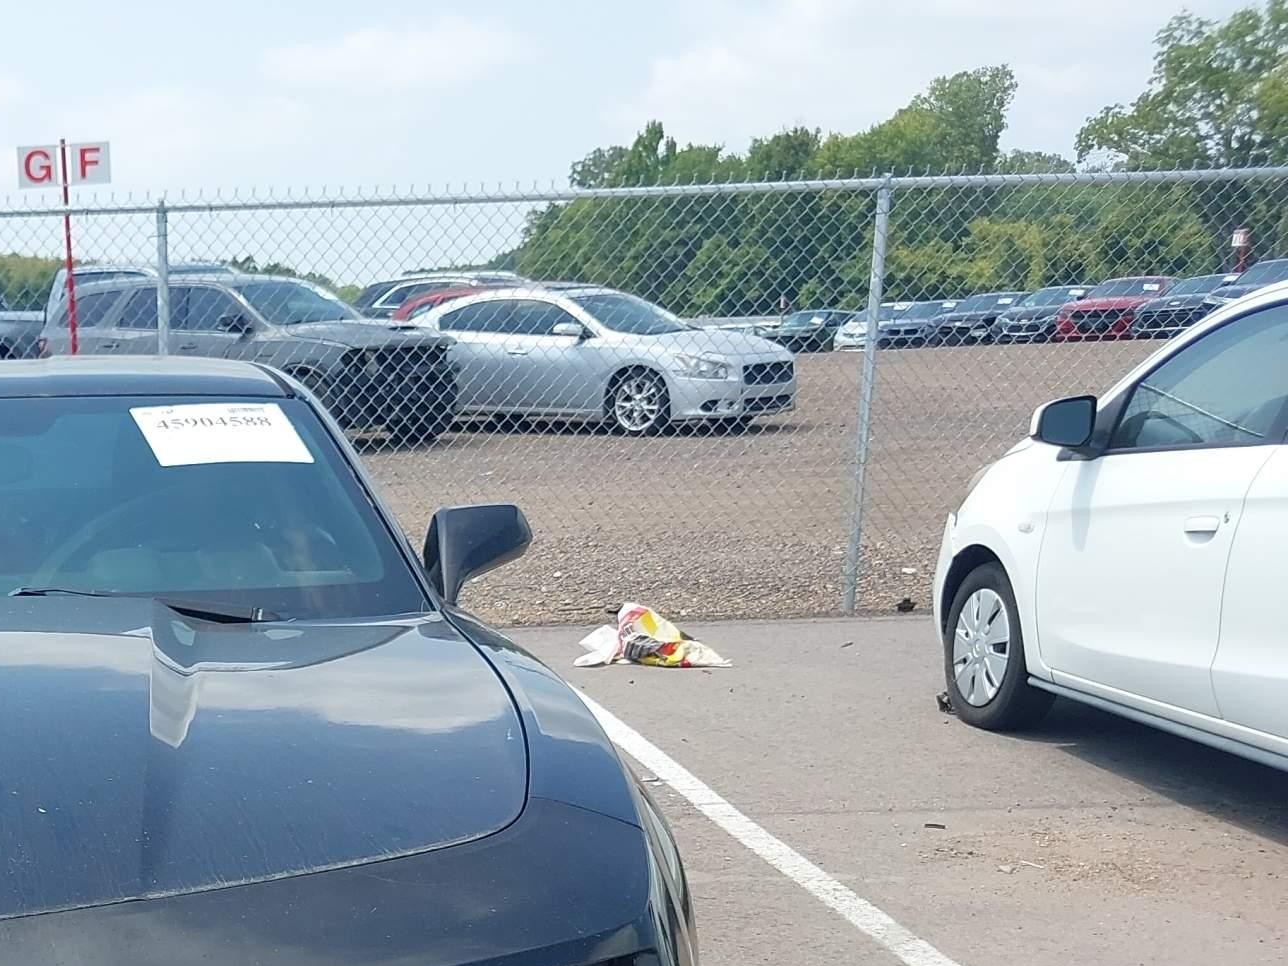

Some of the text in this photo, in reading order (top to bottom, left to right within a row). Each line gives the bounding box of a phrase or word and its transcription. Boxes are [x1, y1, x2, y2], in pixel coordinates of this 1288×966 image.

[24, 149, 52, 183] G
[79, 147, 100, 179] F
[156, 415, 272, 430] 45904588
